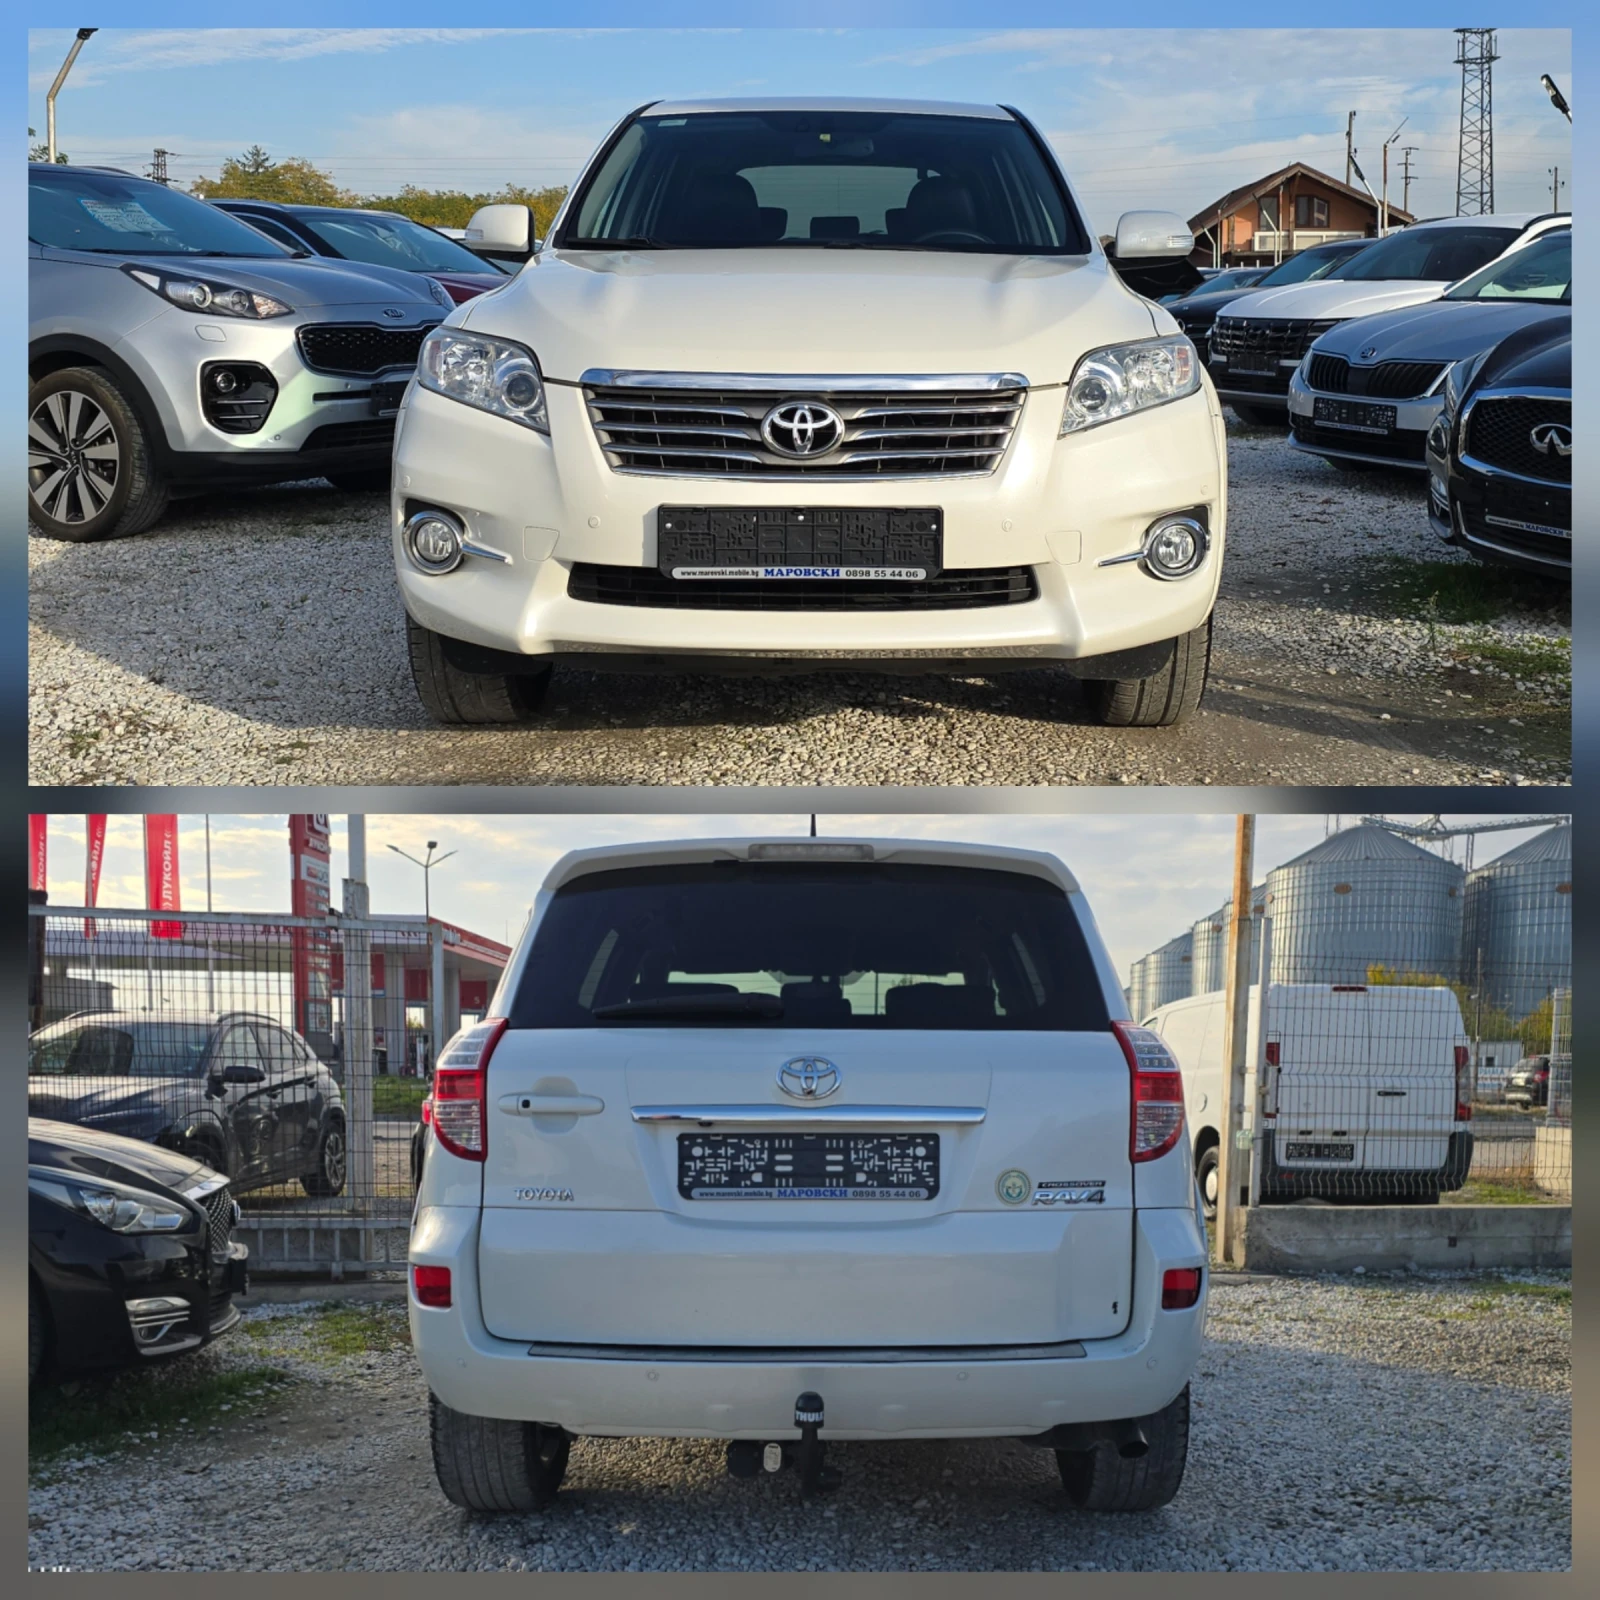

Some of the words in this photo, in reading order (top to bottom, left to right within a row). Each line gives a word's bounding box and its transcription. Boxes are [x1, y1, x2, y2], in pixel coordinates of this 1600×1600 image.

[764, 568, 840, 577] МАРОВСКИ
[845, 569, 871, 577] 0898
[905, 570, 919, 578] 06
[36, 841, 45, 890] УКОЙЛ
[162, 840, 172, 900] ЛУКОЙЛ
[514, 1187, 574, 1201] TOYOTA
[777, 1188, 848, 1198] МАРОВСКИ
[1032, 1190, 1106, 1205] RAV4
